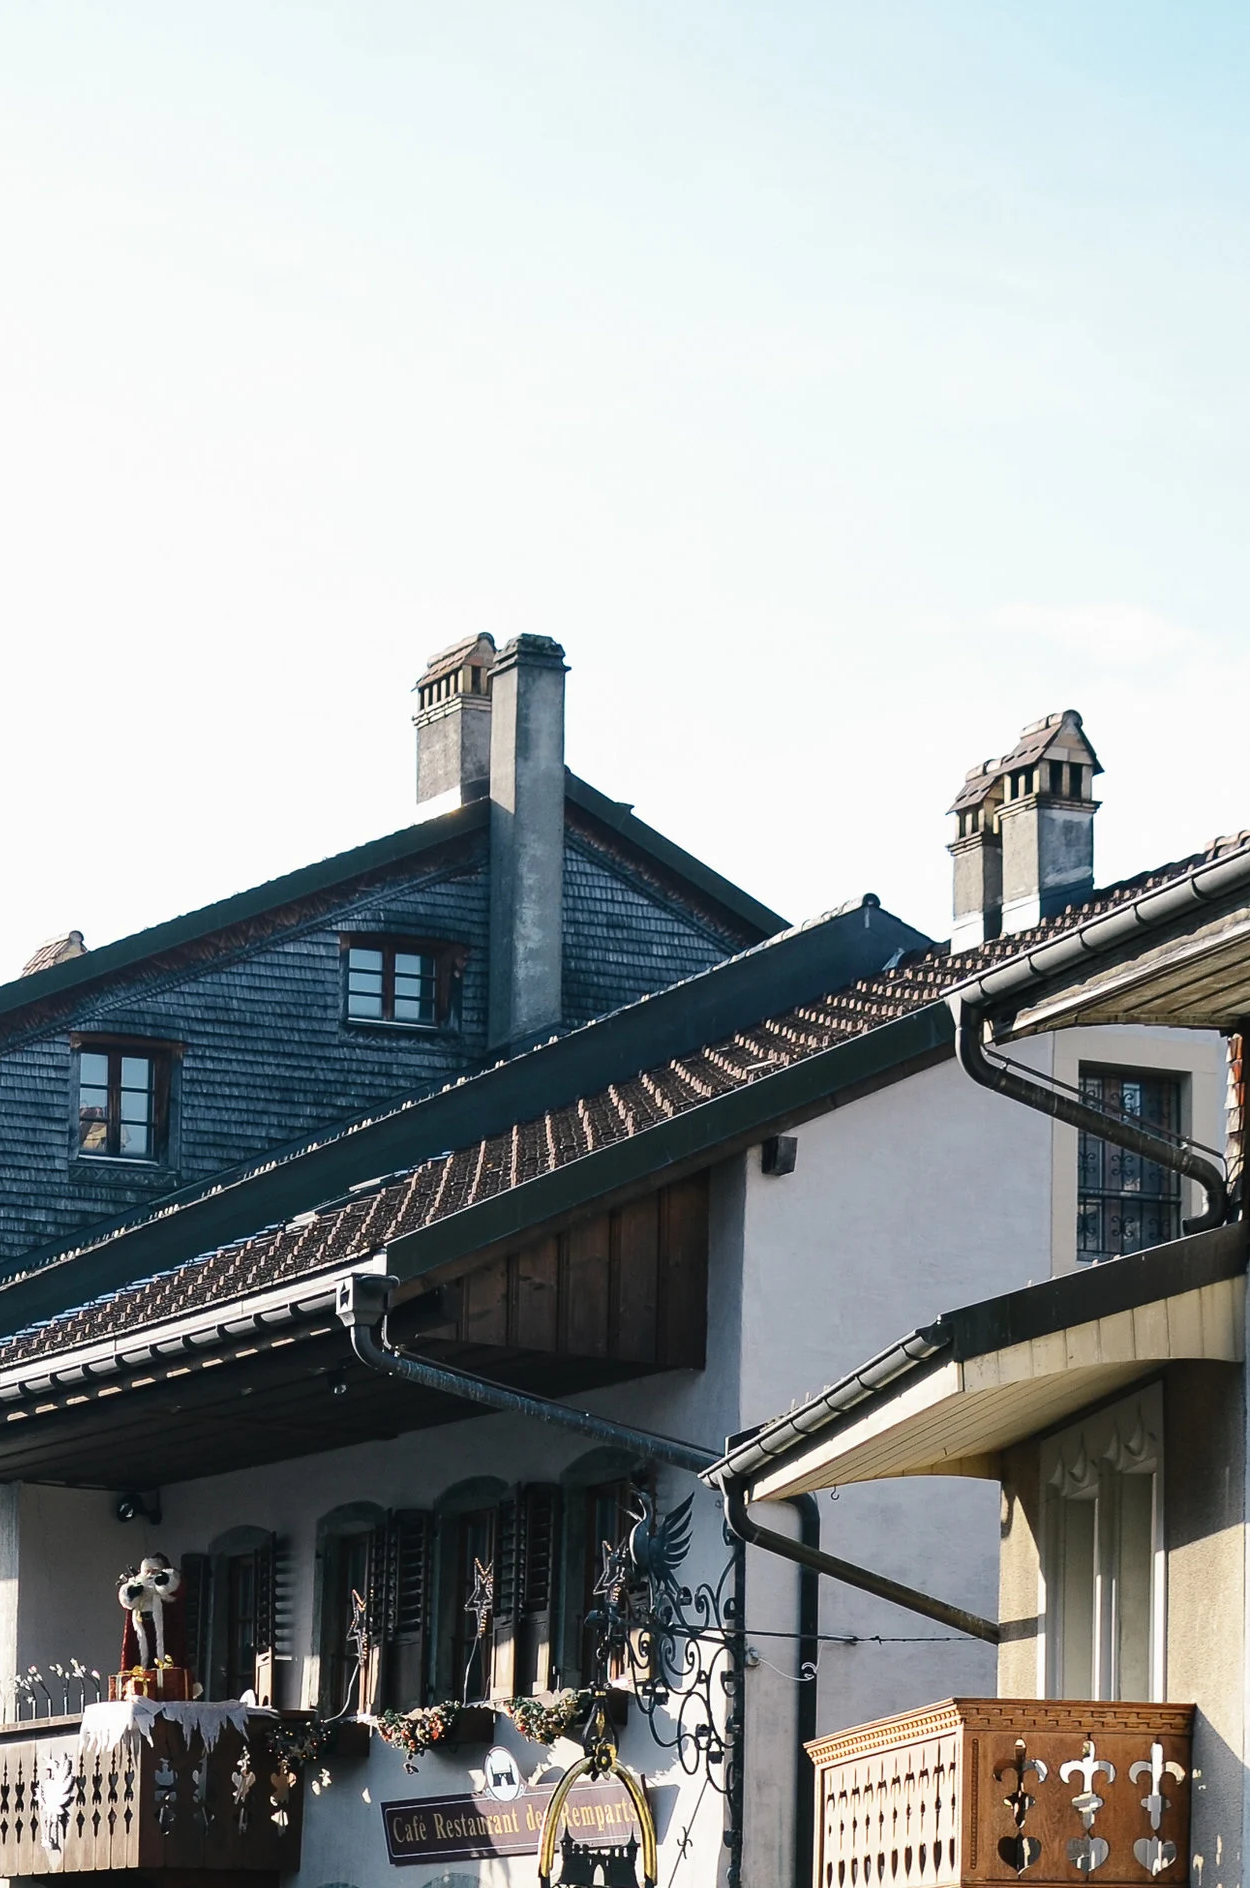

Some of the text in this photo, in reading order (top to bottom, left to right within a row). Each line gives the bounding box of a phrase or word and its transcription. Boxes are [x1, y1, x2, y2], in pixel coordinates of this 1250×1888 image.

[393, 1800, 639, 1843] Café Restaurant de Remparts
